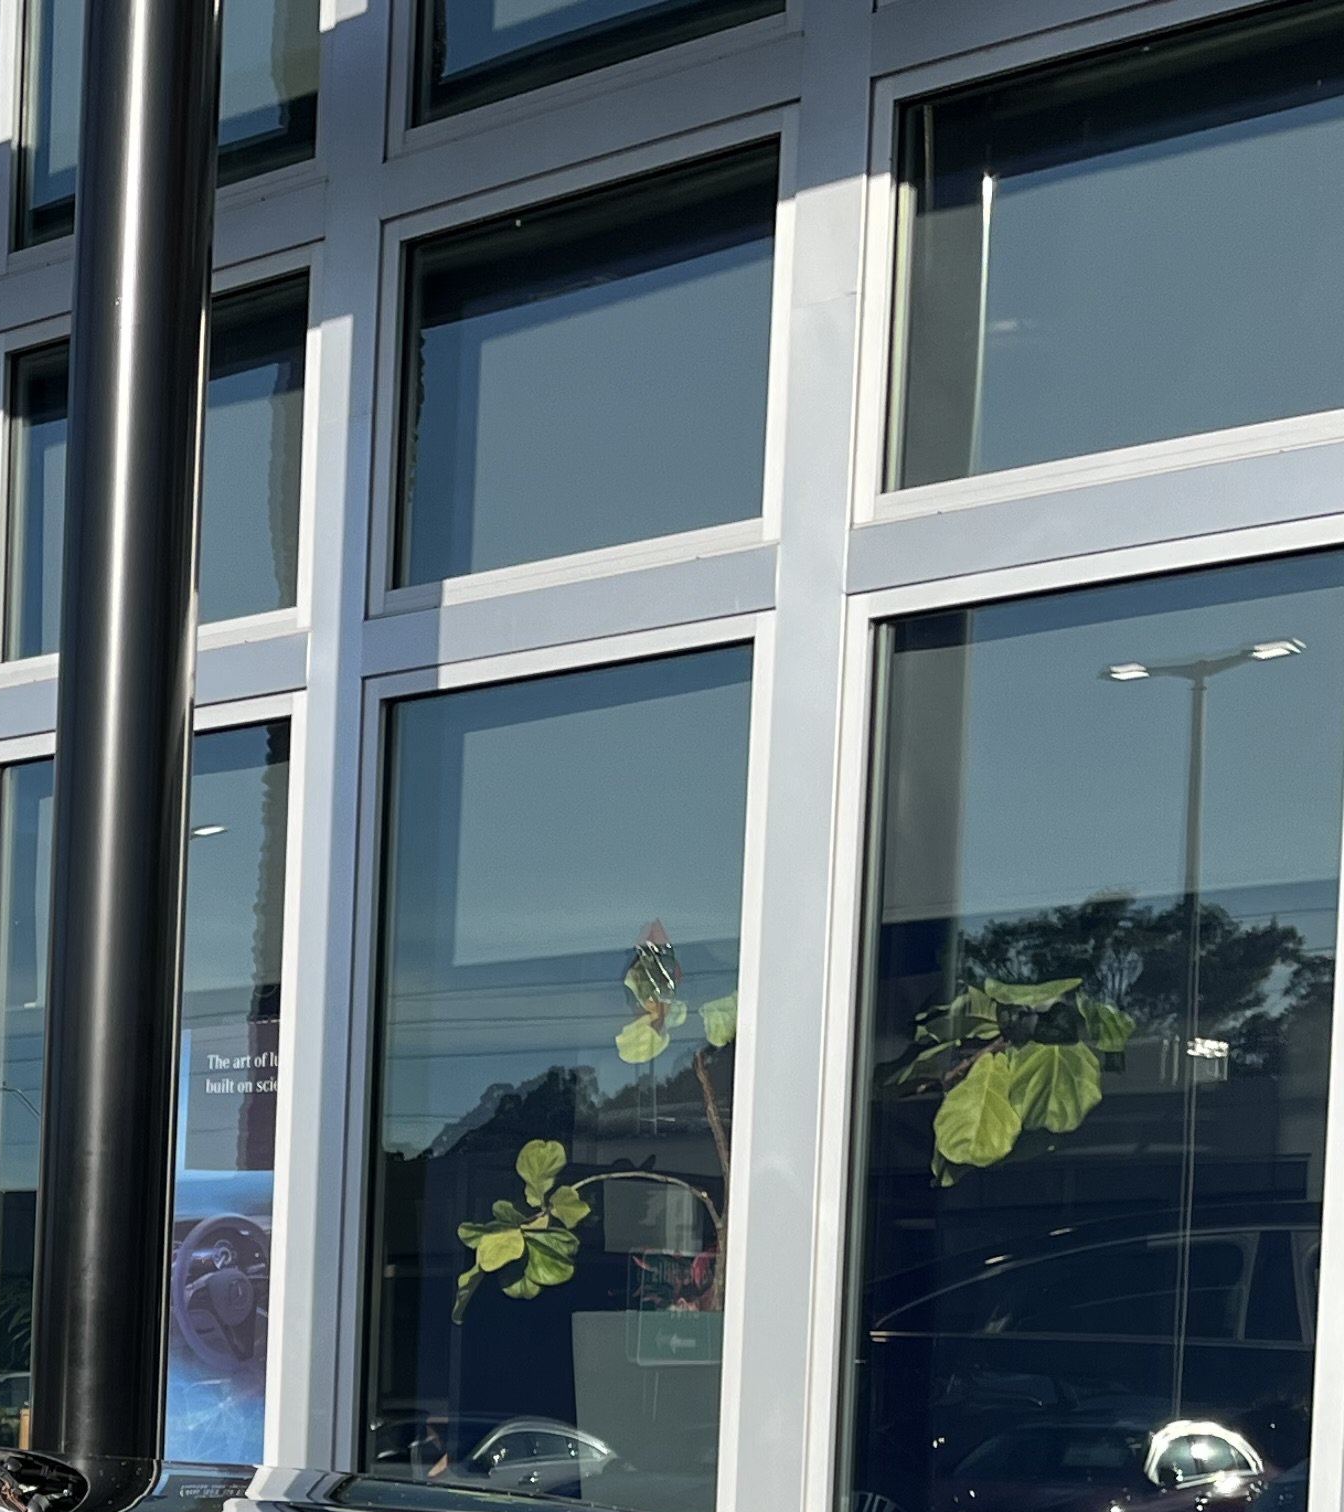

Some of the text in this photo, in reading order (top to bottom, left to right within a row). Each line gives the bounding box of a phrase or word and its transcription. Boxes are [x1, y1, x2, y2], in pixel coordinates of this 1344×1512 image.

[207, 1053, 230, 1070] The
[232, 1054, 251, 1069] art
[254, 1051, 269, 1068] of
[205, 1078, 234, 1094] built
[237, 1081, 253, 1093] on
